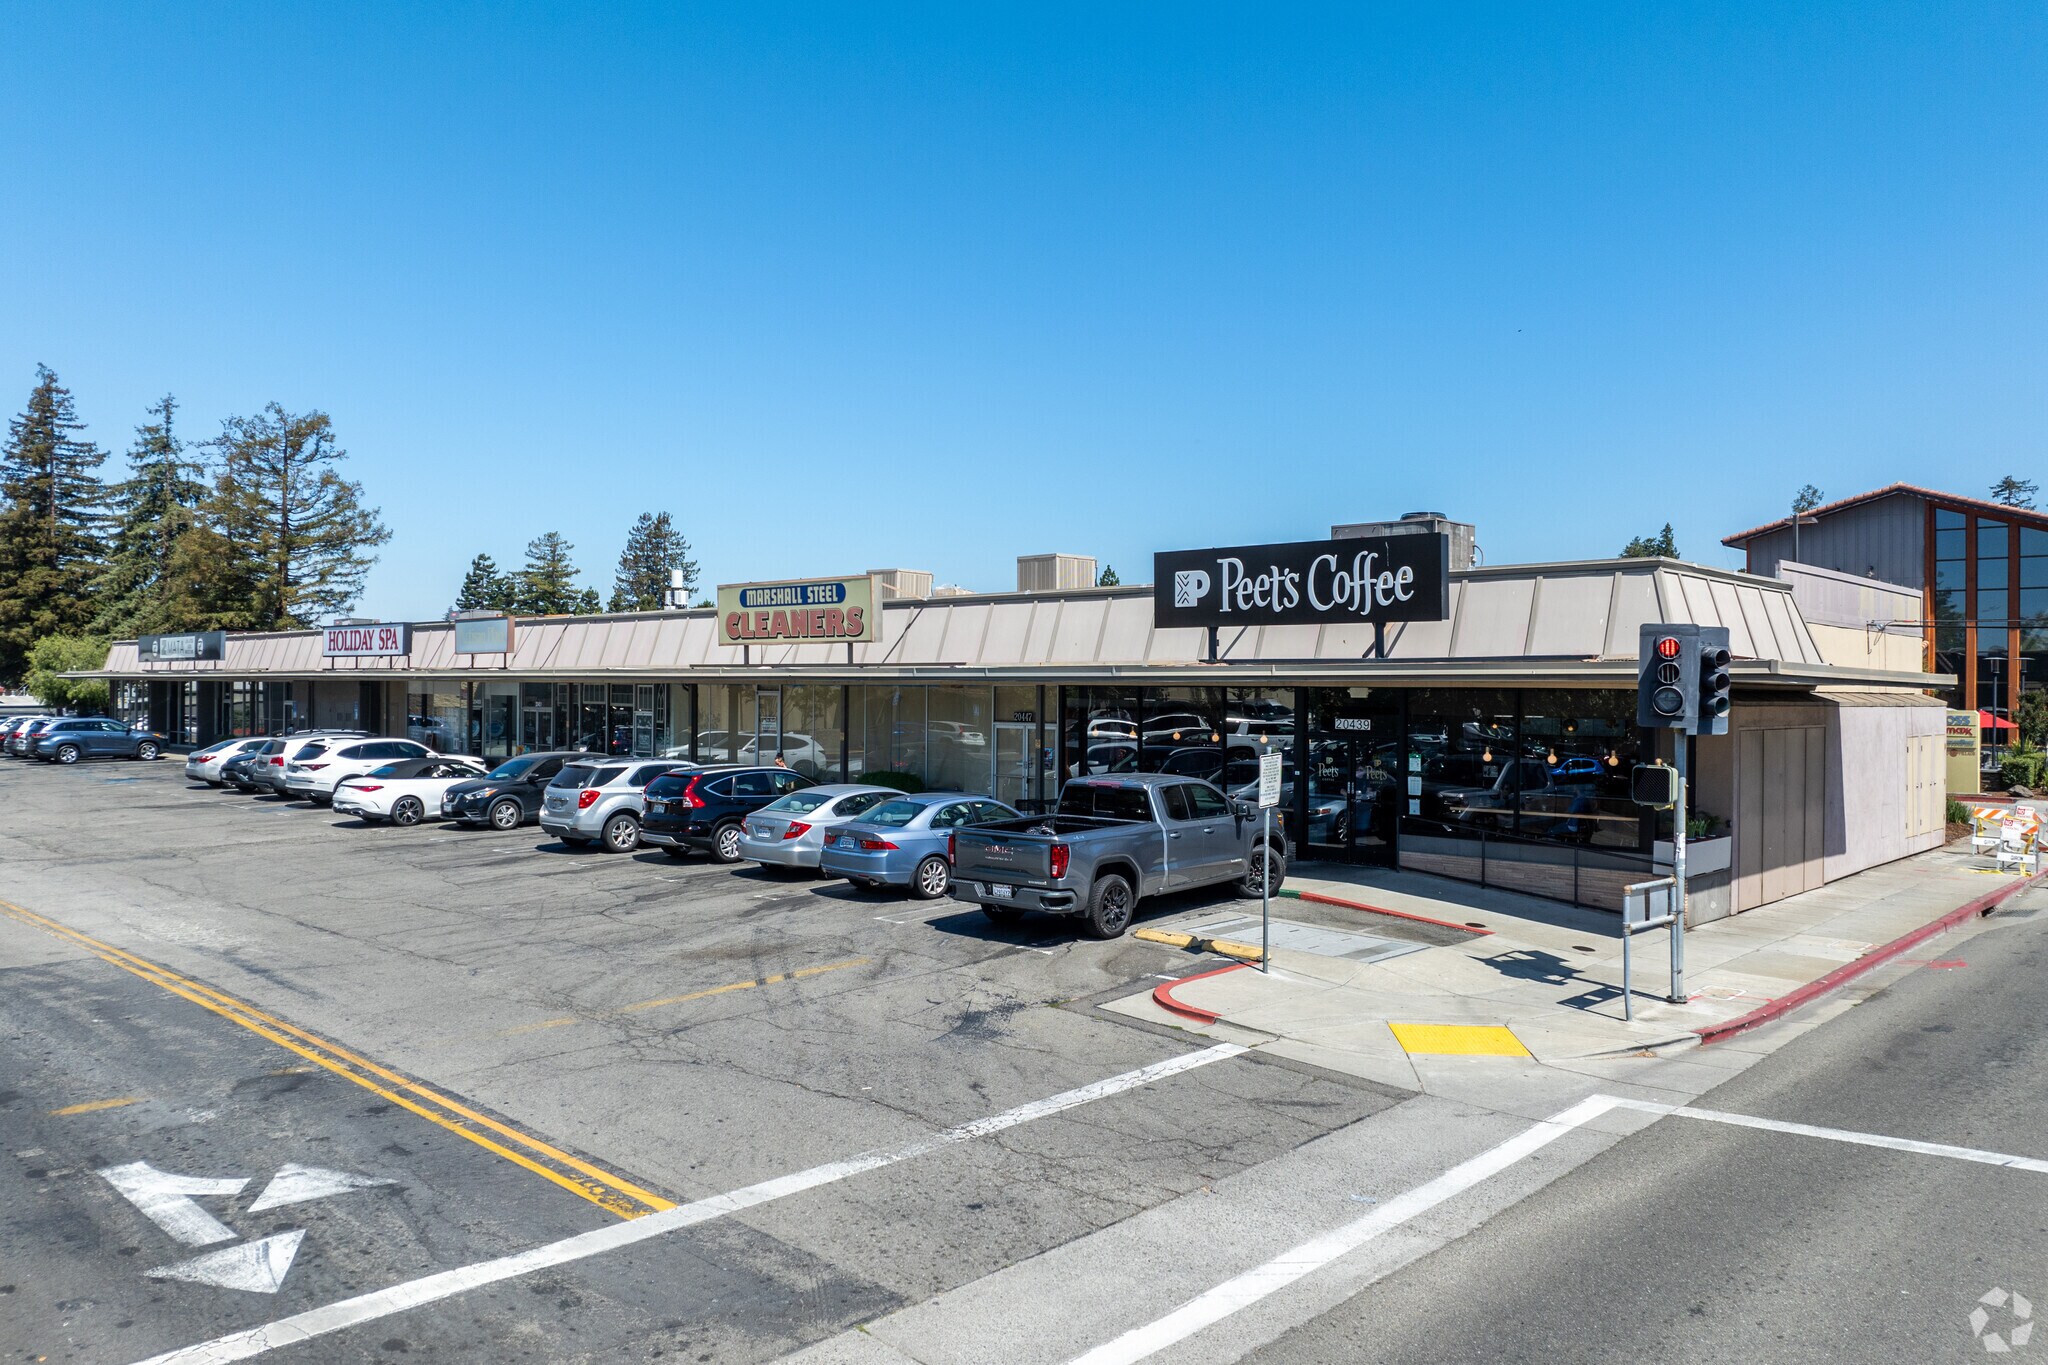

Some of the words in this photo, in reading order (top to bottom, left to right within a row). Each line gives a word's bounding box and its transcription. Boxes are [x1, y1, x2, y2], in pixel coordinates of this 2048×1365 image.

[1216, 557, 1300, 613] Peet's
[1307, 550, 1415, 616] Coffee
[746, 586, 803, 606] MARSHALL
[807, 584, 838, 603] STEEL
[725, 606, 865, 640] CLEANERS
[328, 629, 375, 651] HOLIDAY
[378, 628, 399, 650] SPA
[1014, 712, 1033, 722] 20447
[1336, 719, 1370, 730] 20439
[1946, 715, 1971, 726] OSS
[1946, 727, 1973, 736] maxx
